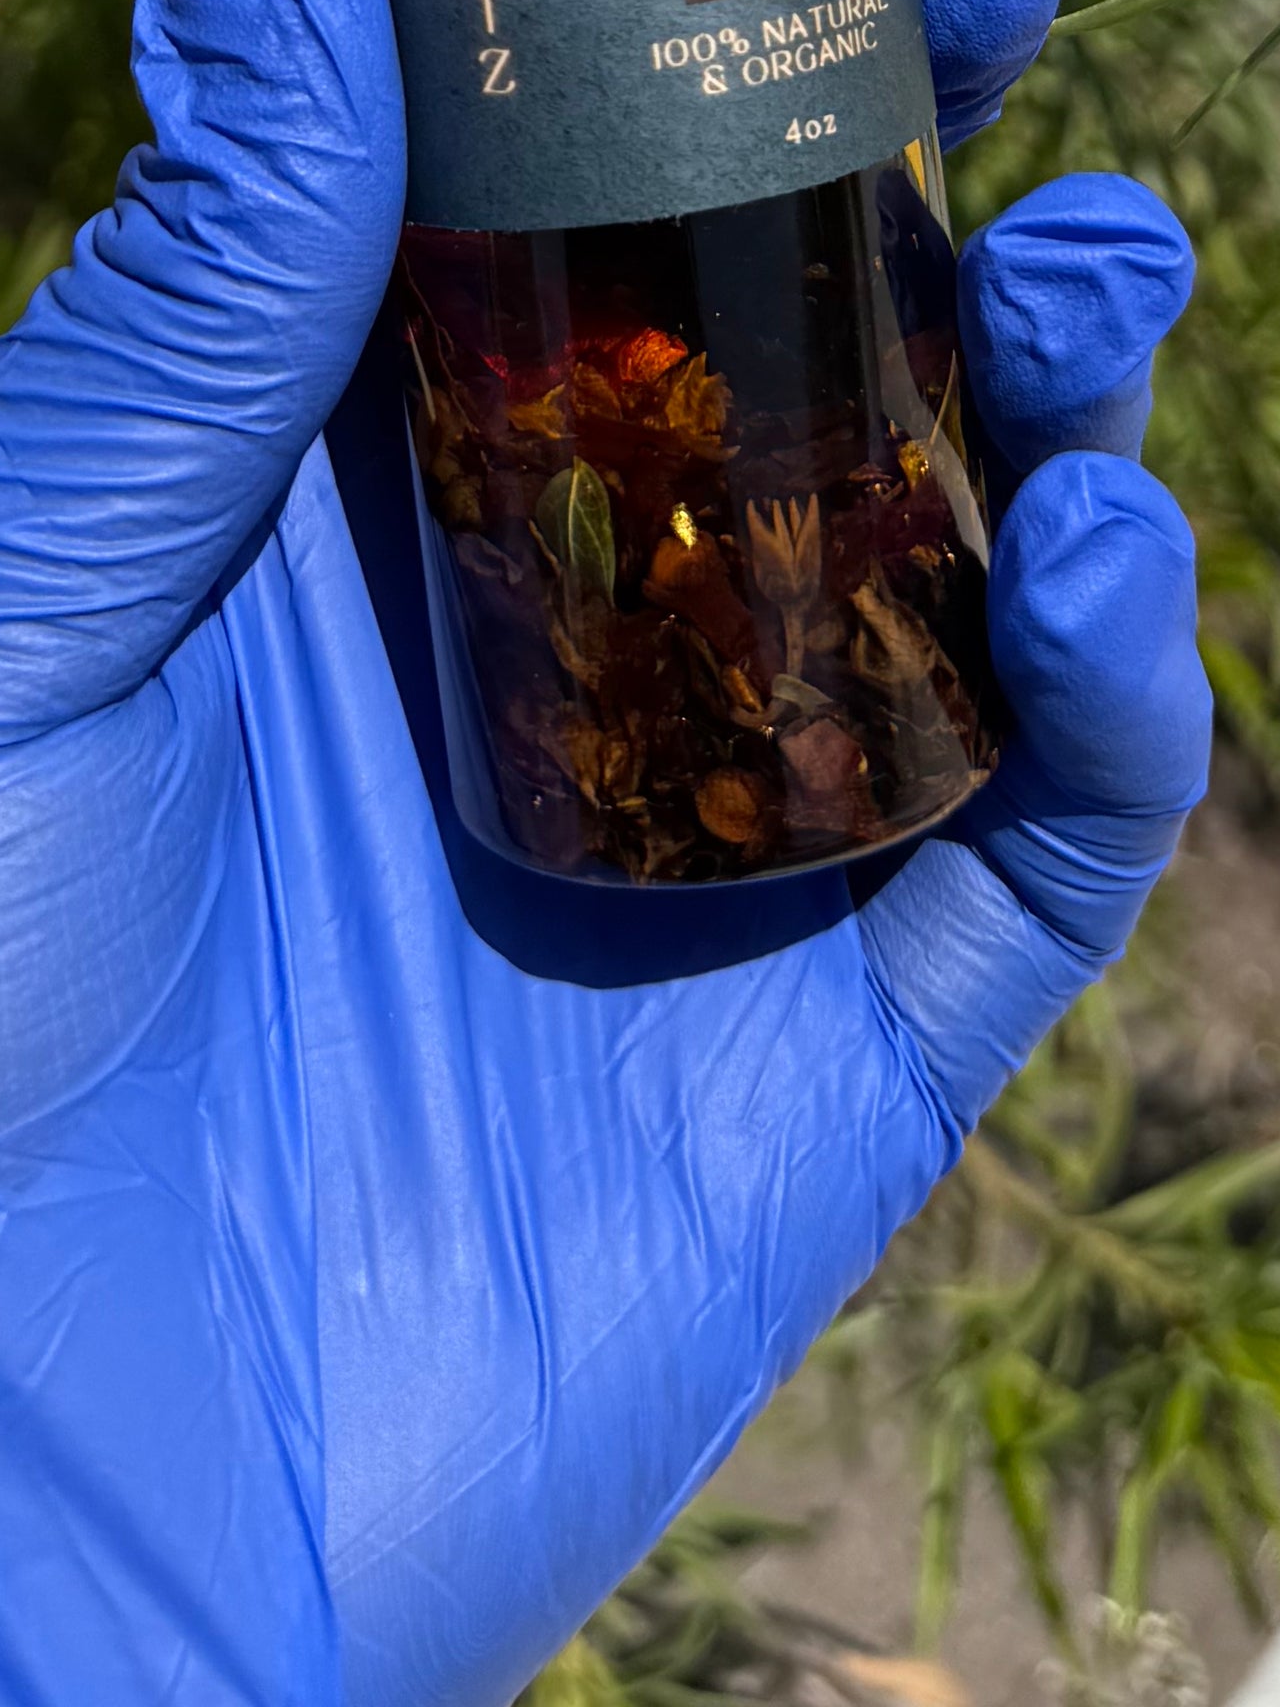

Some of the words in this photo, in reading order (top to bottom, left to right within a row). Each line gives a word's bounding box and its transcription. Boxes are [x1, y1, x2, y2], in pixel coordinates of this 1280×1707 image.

[651, 27, 750, 71] 100%
[702, 64, 729, 96] &
[741, 21, 878, 86] ORGANIC
[784, 113, 838, 145] 4oz
